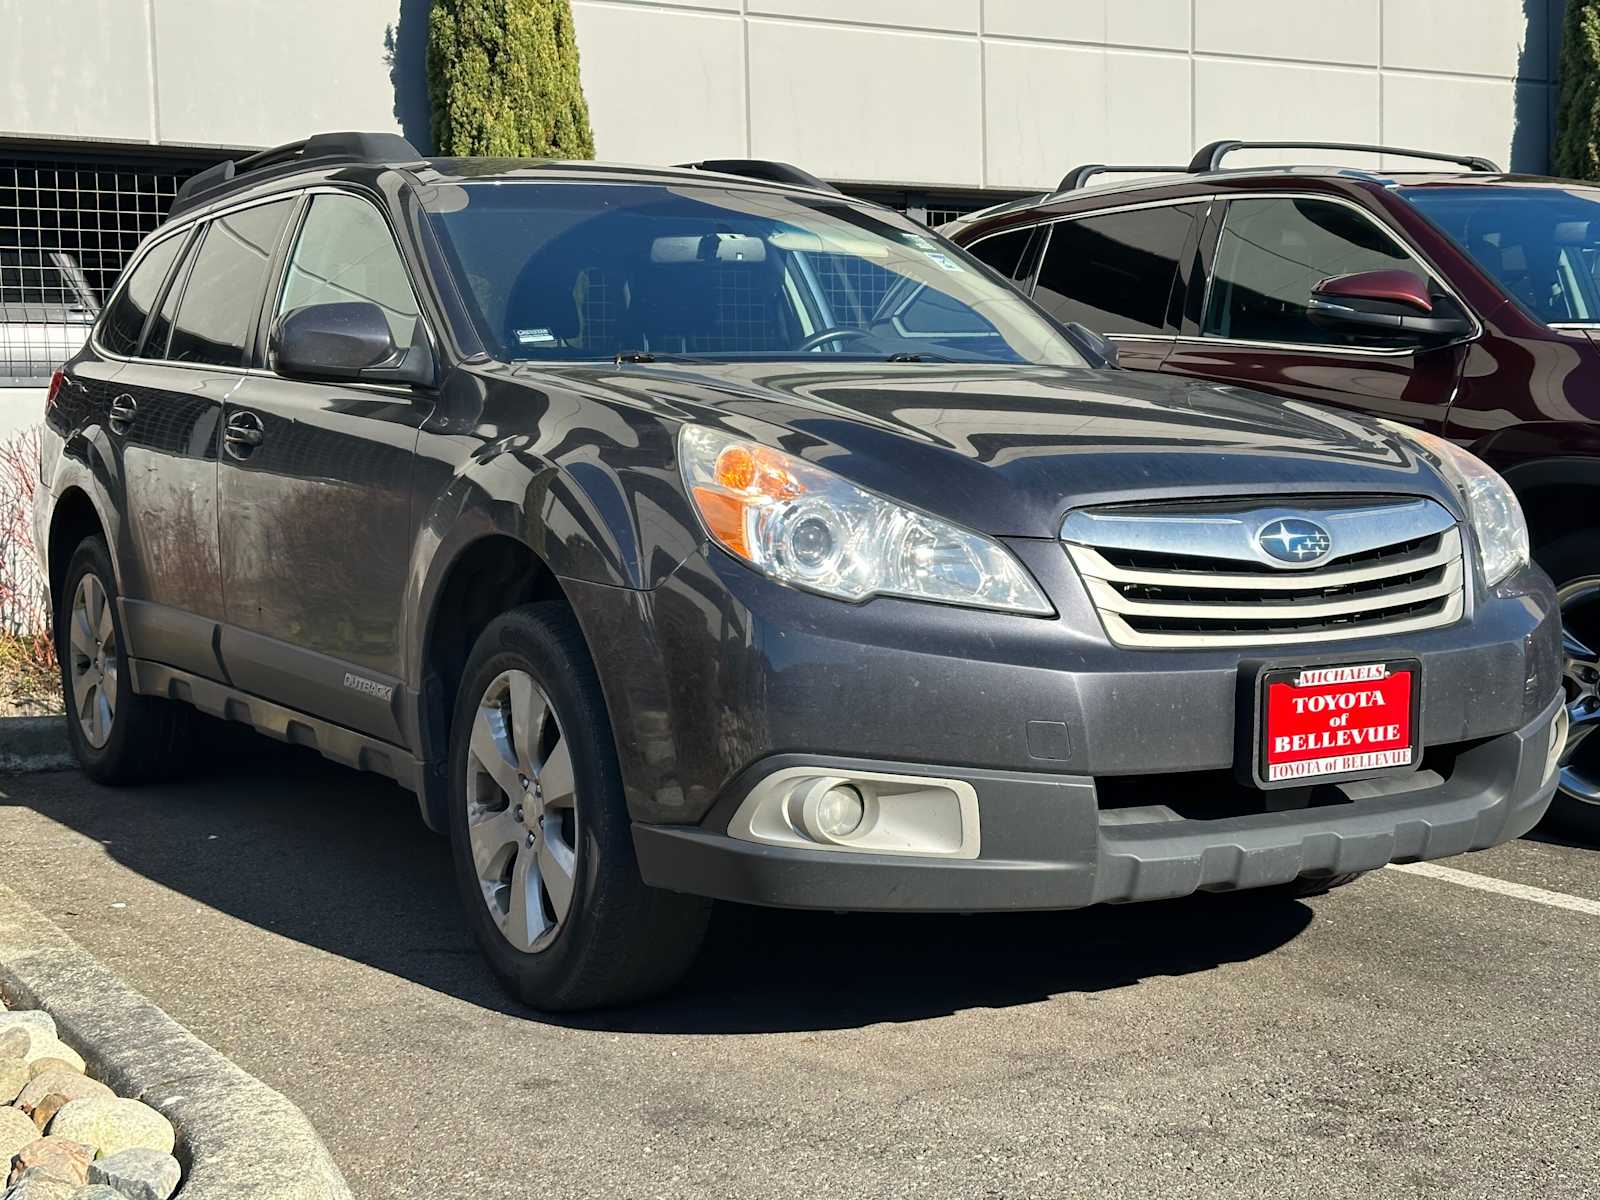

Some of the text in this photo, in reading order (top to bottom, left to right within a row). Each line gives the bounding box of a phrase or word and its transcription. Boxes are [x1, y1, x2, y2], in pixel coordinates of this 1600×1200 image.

[343, 672, 392, 702] OUTBACK
[1302, 665, 1383, 685] MICHAELS
[1292, 690, 1385, 714] TOYOTA
[1329, 712, 1349, 727] of
[1274, 724, 1400, 754] BELLEVUE
[1271, 750, 1410, 779] TOYOTA of BELLEVUE
